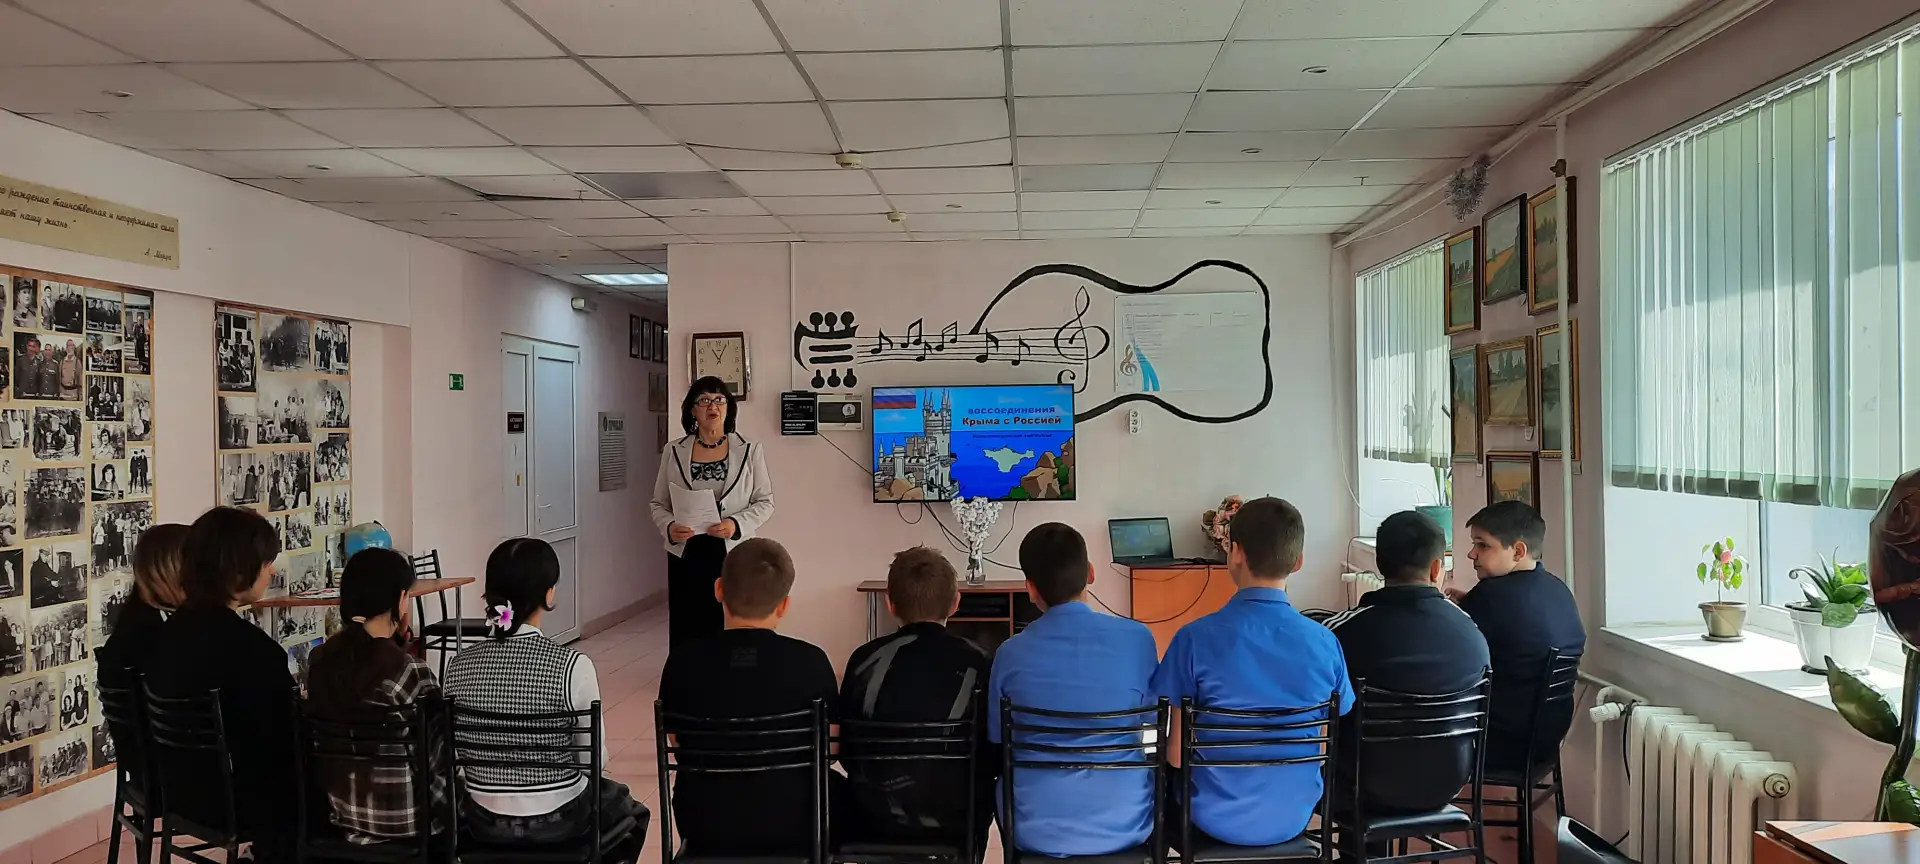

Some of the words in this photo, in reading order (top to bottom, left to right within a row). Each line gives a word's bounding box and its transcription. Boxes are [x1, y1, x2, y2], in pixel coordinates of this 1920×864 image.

[968, 406, 1055, 415] воссоединения
[962, 416, 1000, 427] Крыма
[1004, 417, 1010, 425] с
[1013, 415, 1061, 425] Россией
